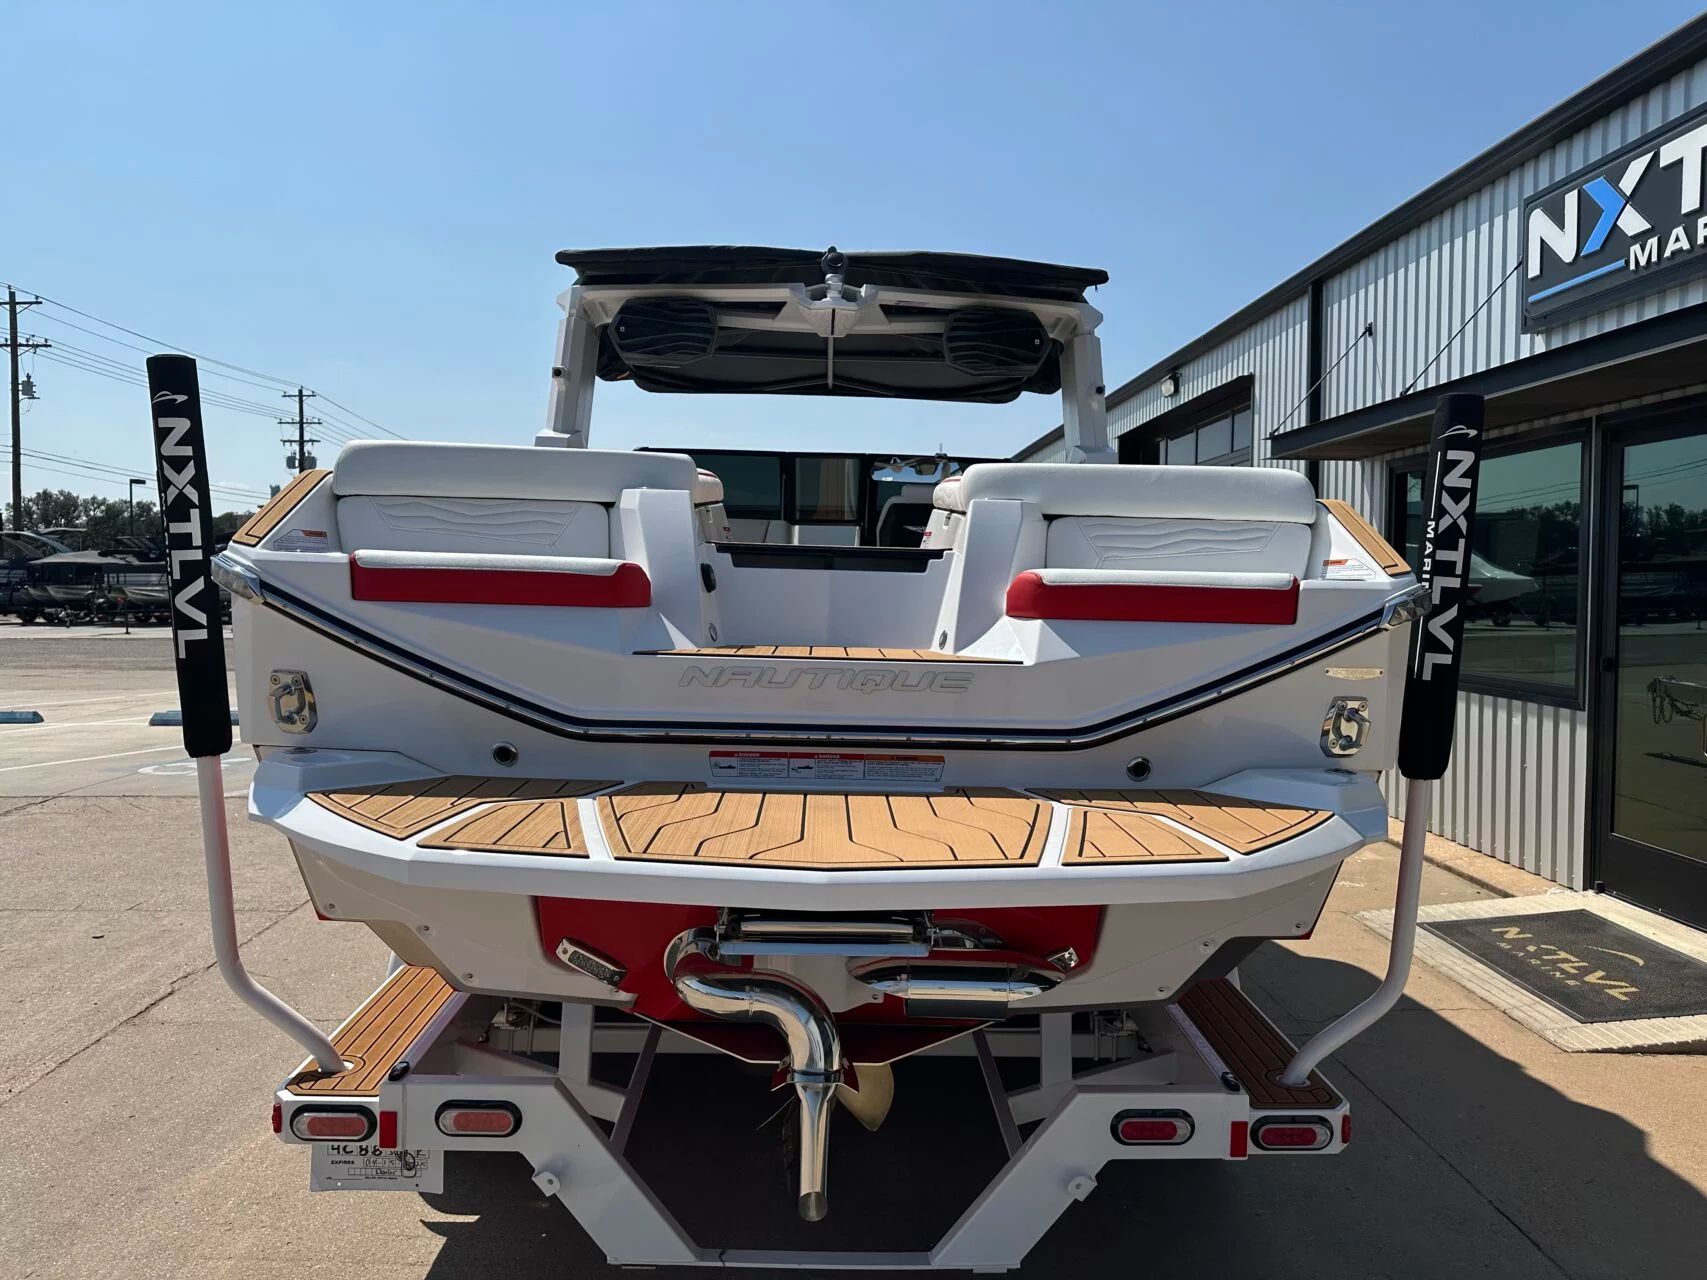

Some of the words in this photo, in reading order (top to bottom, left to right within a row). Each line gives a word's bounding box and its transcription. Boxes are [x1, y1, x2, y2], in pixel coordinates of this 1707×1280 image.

[158, 417, 208, 659] NXTLVL
[1423, 451, 1476, 680] NXTLVL
[677, 664, 976, 695] NAUTIQUE
